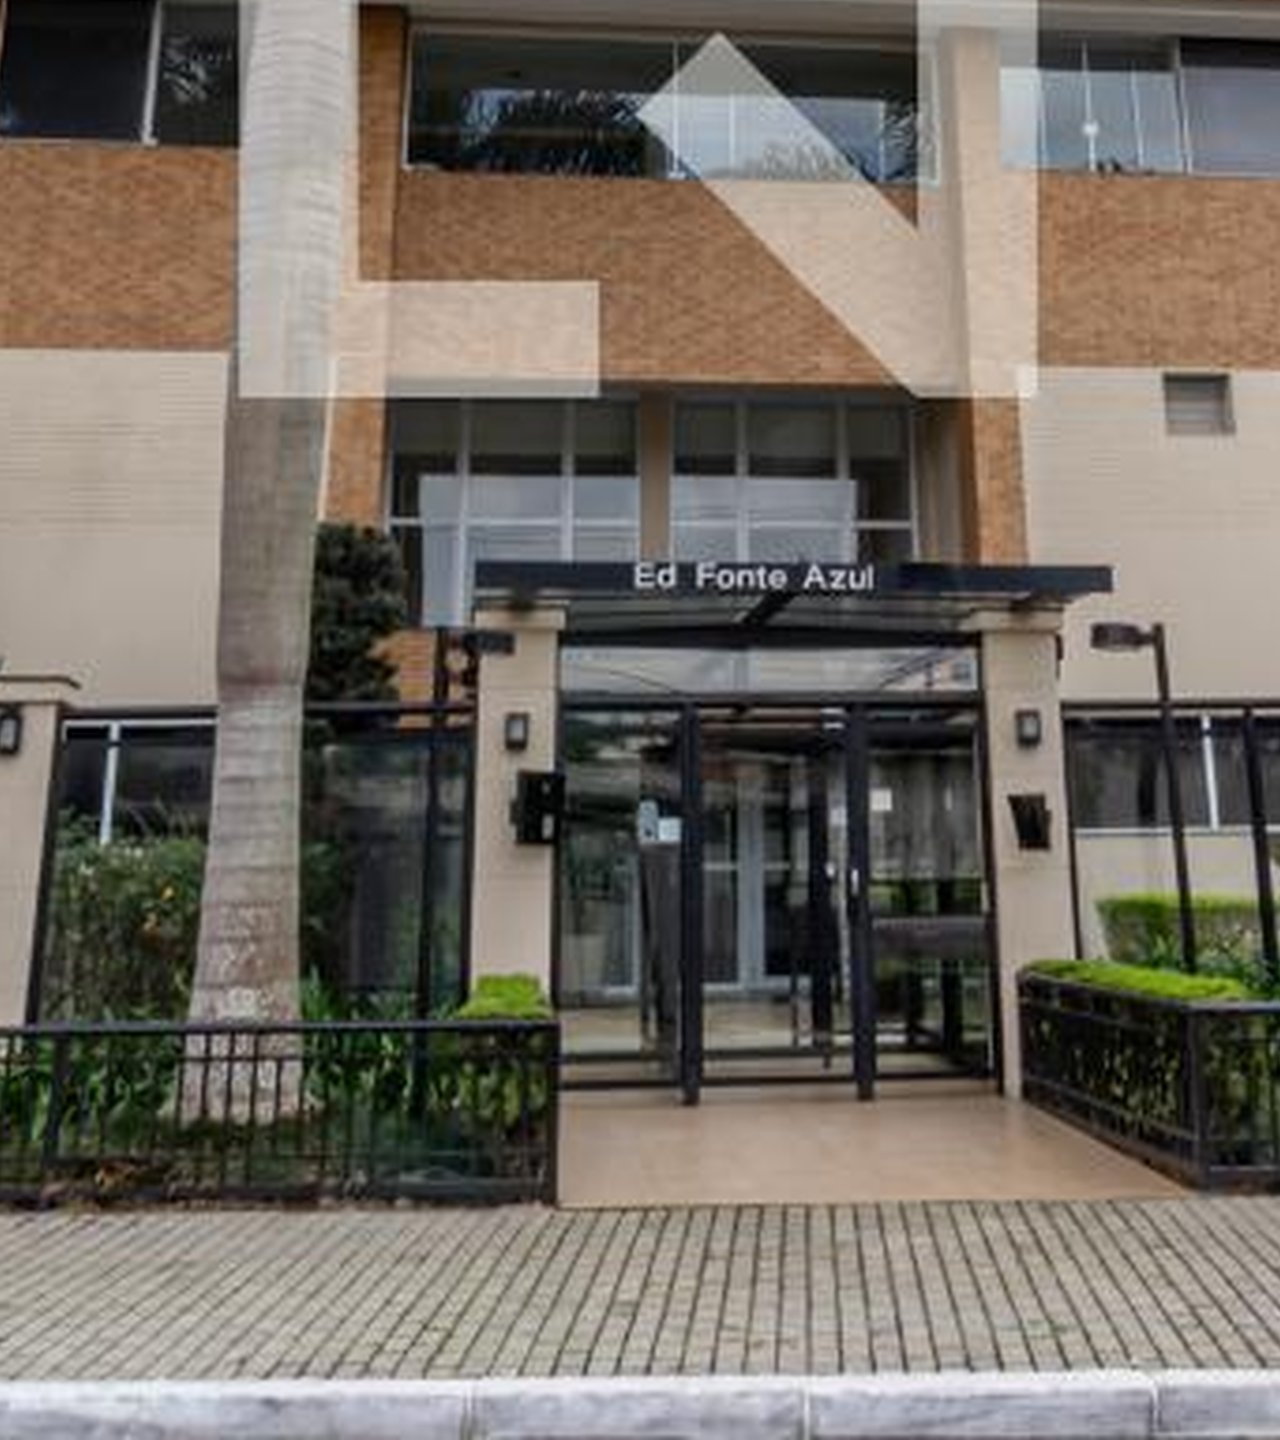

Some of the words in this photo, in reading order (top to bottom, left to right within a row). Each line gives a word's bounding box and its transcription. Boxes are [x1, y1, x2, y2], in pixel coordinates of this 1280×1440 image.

[634, 562, 677, 589] Ed
[696, 562, 788, 590] Fonte
[803, 563, 875, 590] Azul
